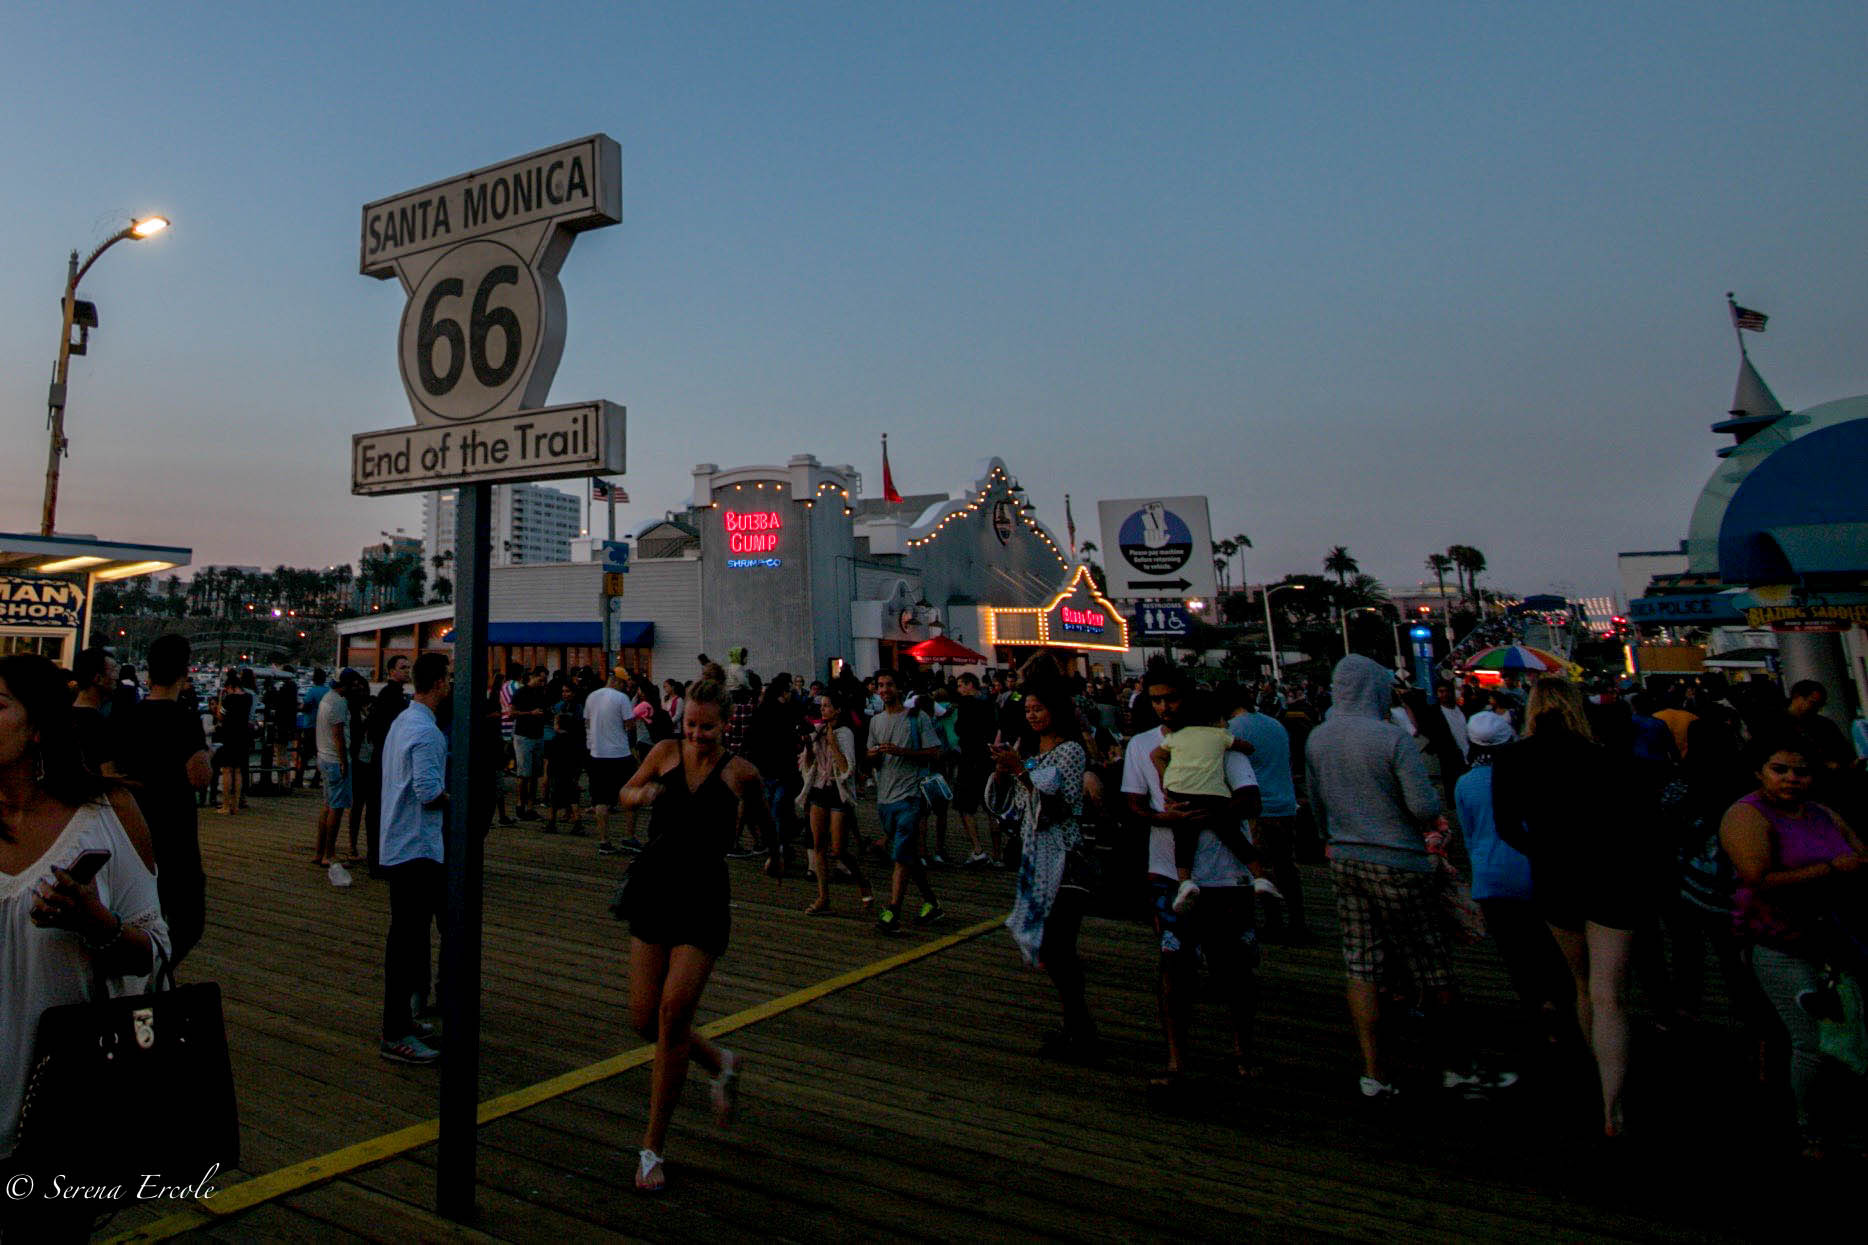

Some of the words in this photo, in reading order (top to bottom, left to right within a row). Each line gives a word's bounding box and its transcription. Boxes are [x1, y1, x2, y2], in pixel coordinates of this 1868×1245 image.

[369, 196, 451, 254] SANTA
[464, 156, 589, 229] MONICA
[417, 265, 521, 396] 66
[362, 437, 411, 478] End
[421, 432, 452, 471] of
[460, 429, 509, 467] the
[514, 414, 589, 460] Trail
[725, 511, 781, 531] BUBBA
[731, 533, 777, 552] GUMP
[1658, 599, 1713, 616] POLICE
